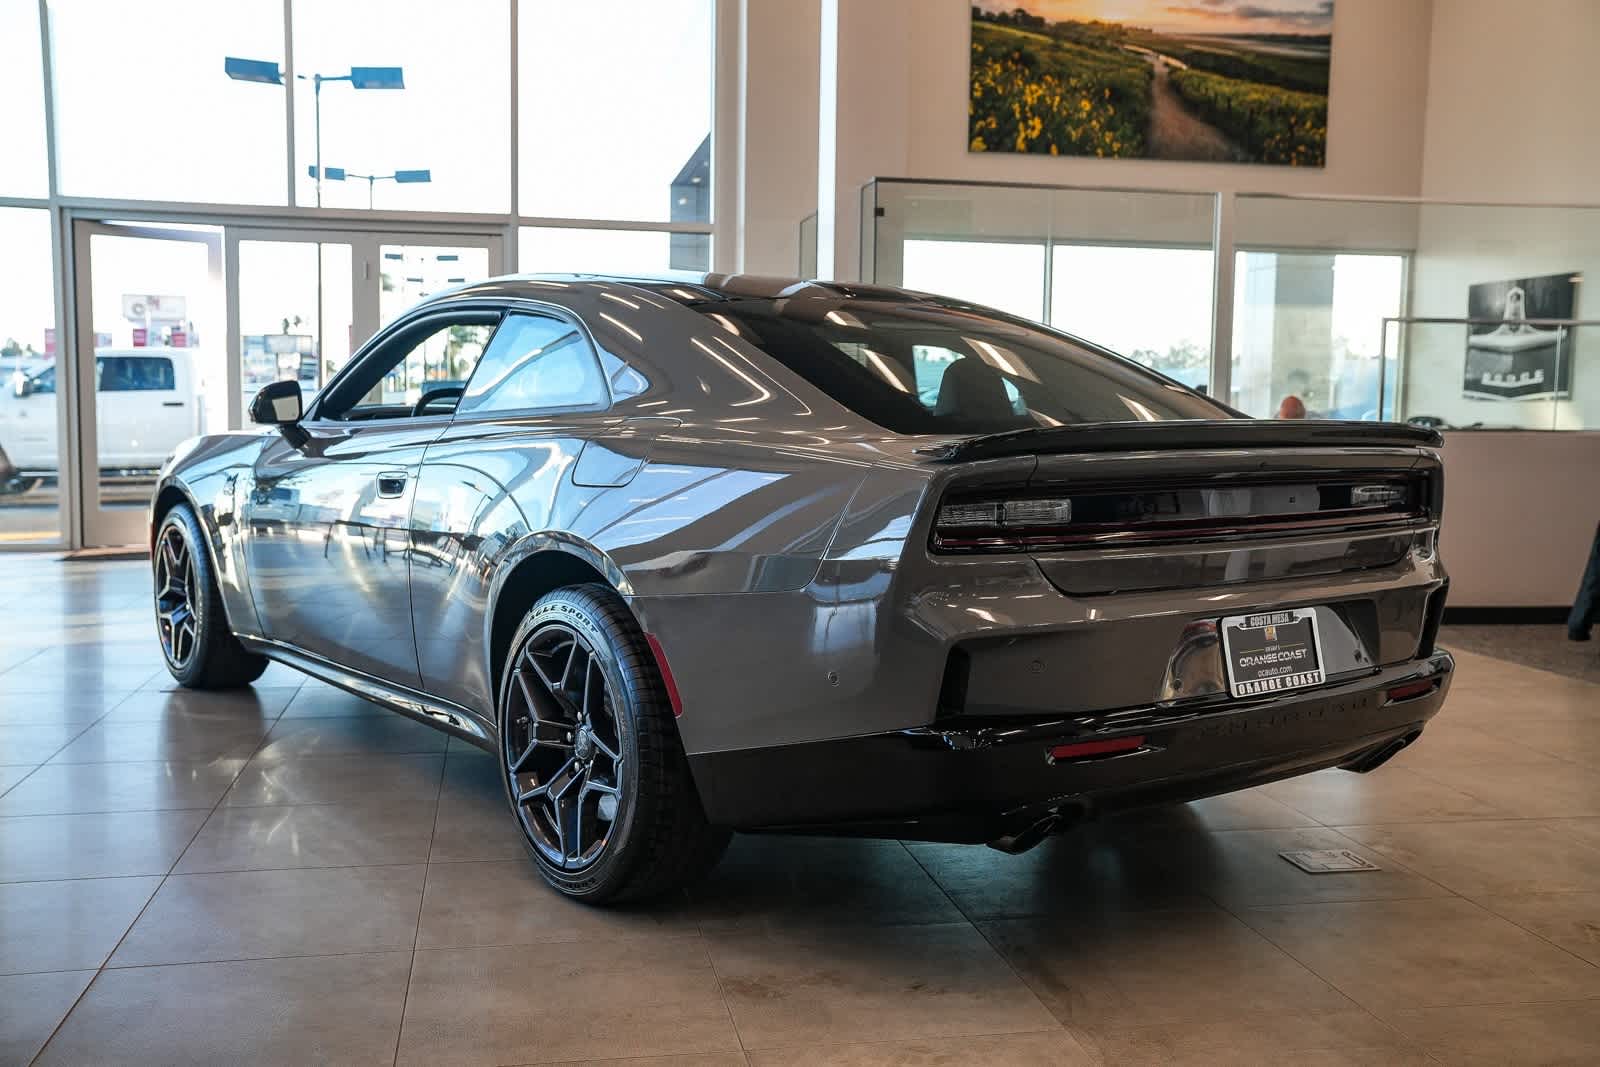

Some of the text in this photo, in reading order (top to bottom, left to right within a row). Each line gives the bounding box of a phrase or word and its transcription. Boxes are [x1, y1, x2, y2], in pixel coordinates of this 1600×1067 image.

[560, 605, 599, 633] SPORT
[1250, 614, 1272, 627] COSTA
[1238, 672, 1320, 695] ORANGE COAST
